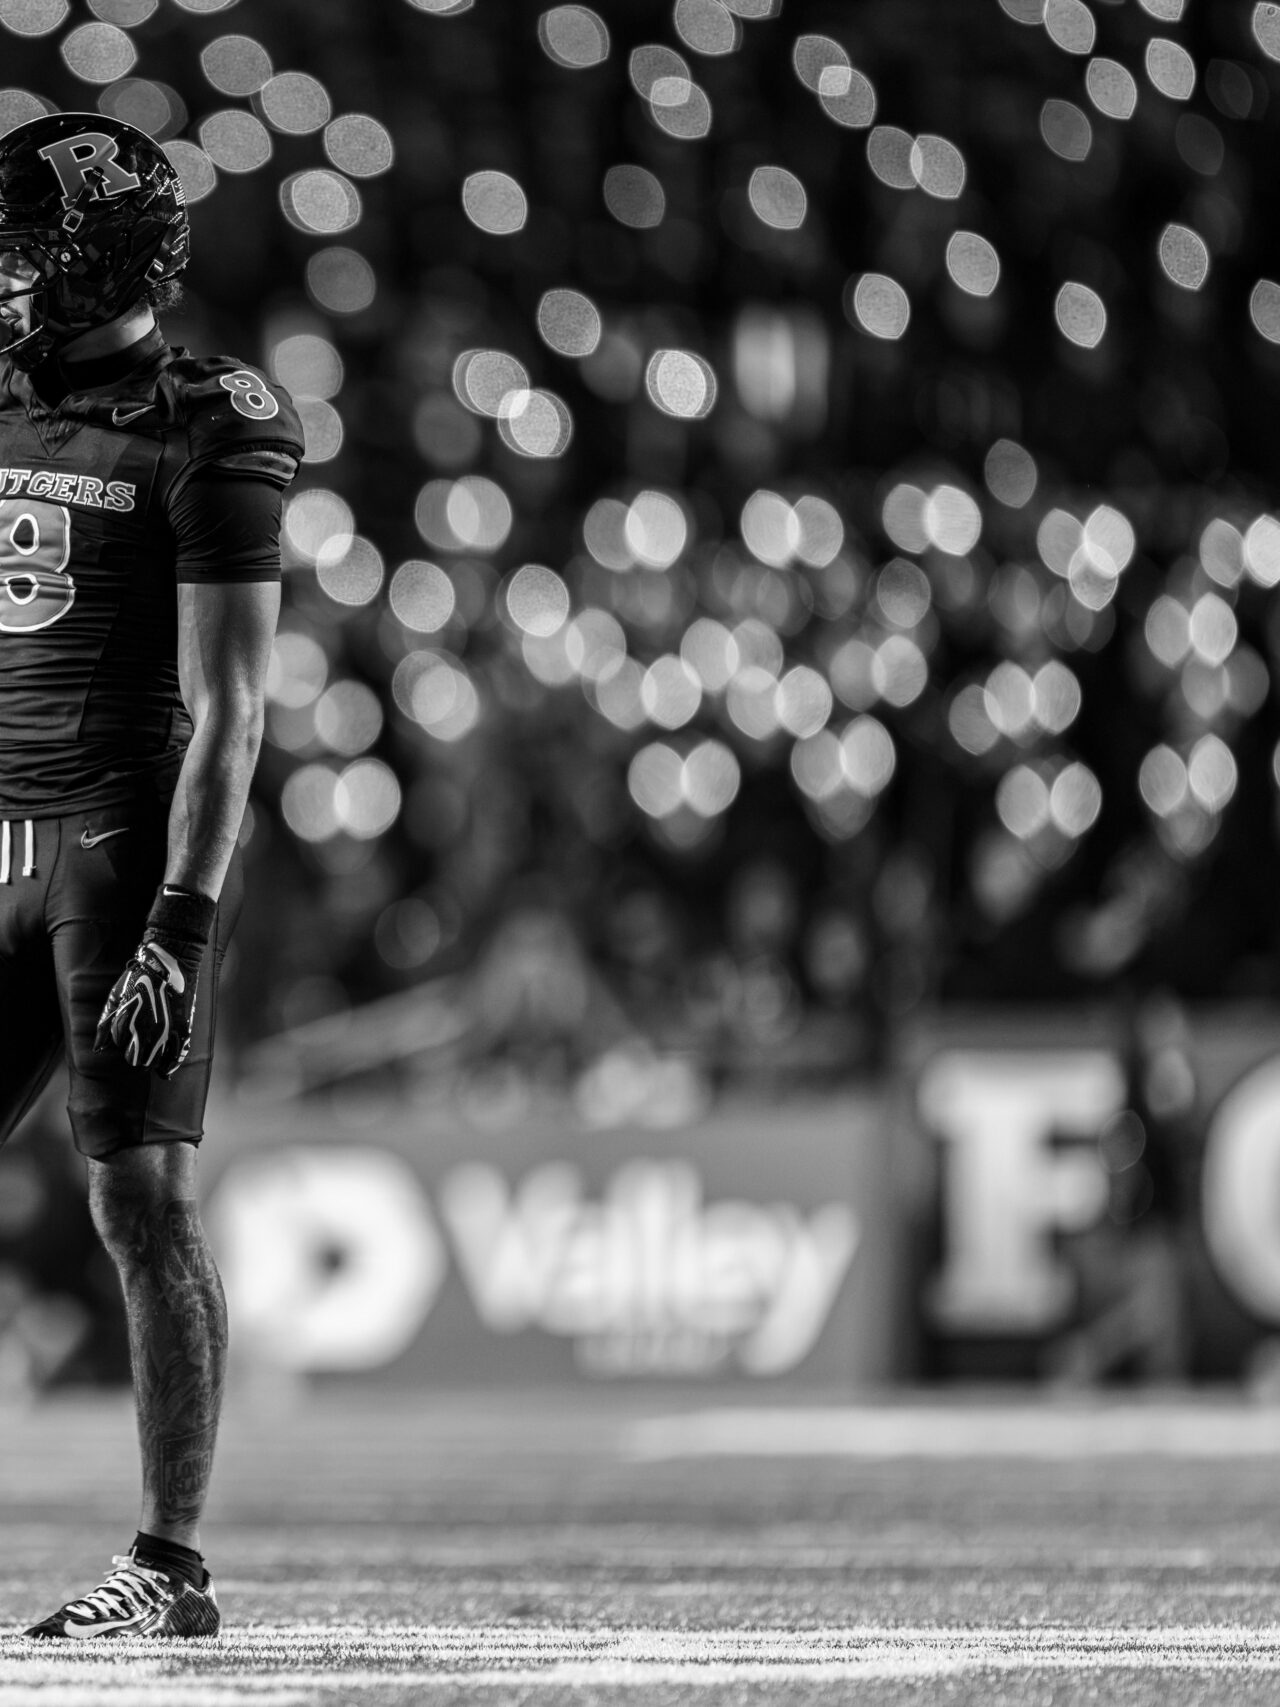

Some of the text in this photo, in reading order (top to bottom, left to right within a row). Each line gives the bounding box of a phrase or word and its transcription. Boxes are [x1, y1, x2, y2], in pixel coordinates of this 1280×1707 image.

[38, 132, 140, 210] R
[220, 371, 278, 419] 8
[438, 1157, 862, 1377] Valley
